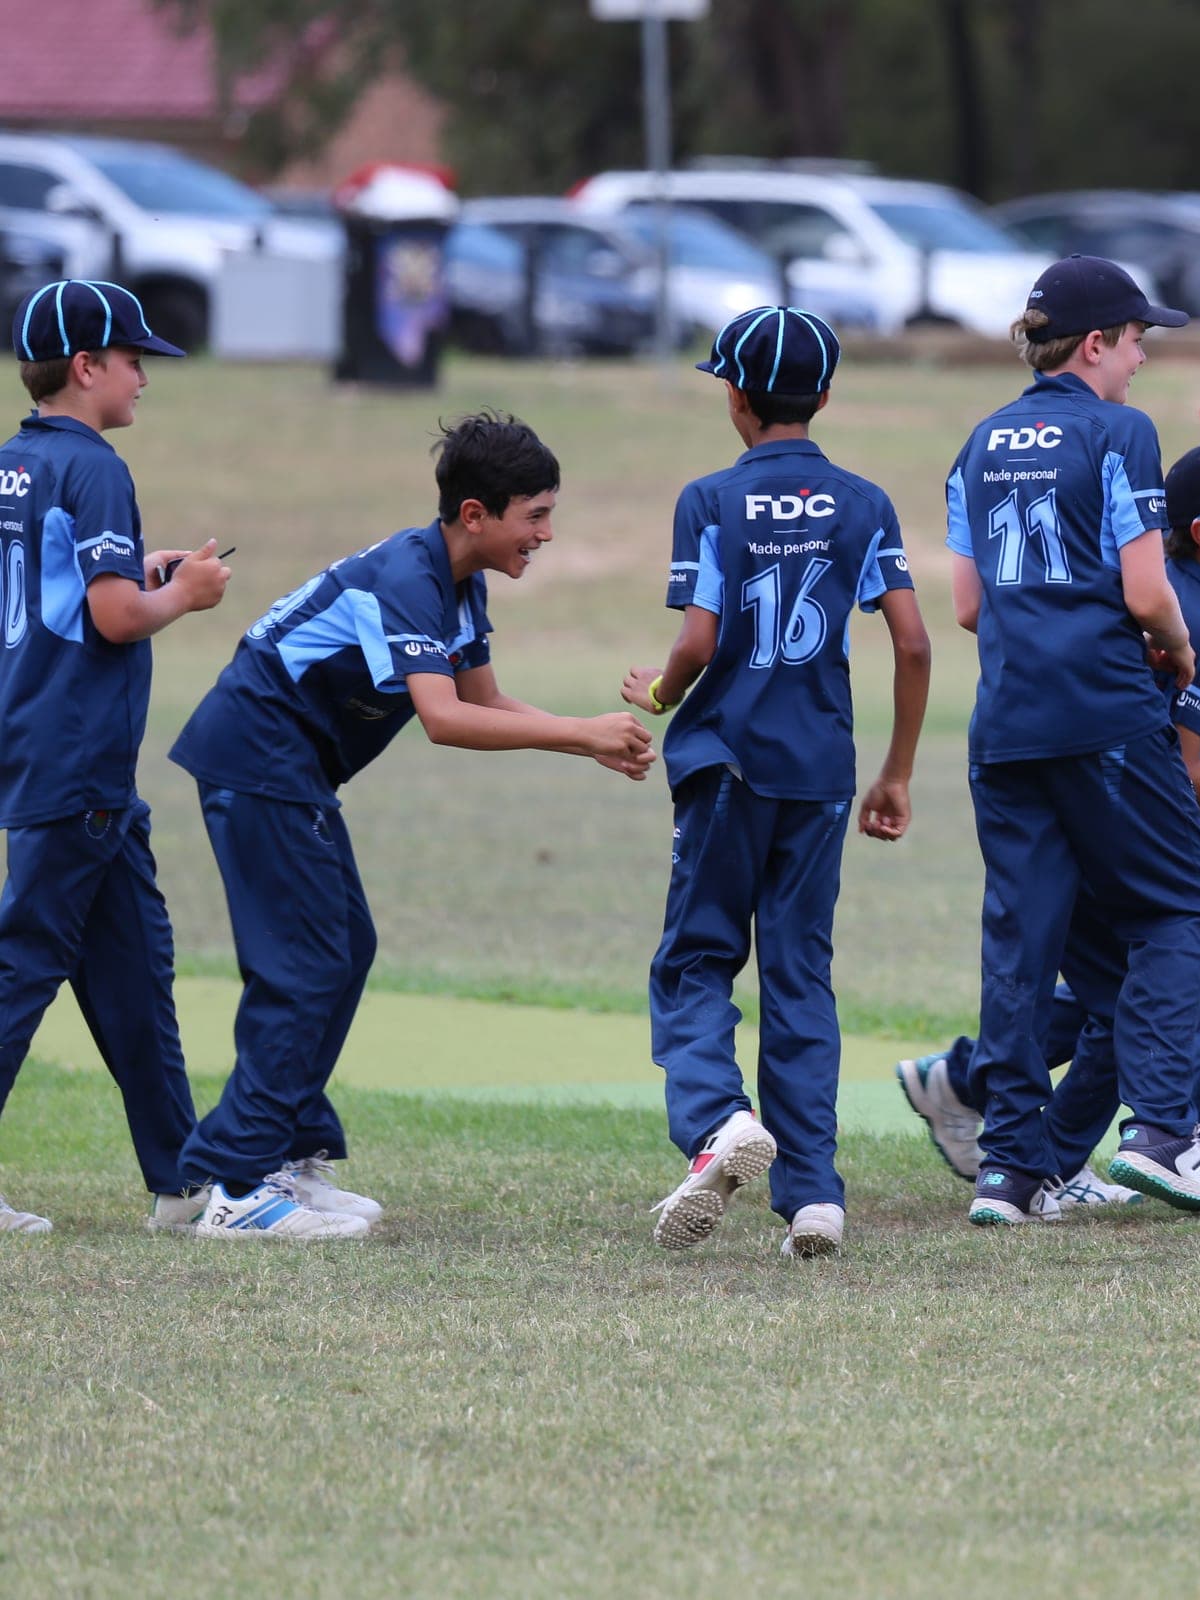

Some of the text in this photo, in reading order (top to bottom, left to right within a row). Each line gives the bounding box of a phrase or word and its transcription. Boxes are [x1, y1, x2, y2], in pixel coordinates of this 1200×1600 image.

[987, 426, 1063, 451] FDC
[0, 469, 31, 497] DC
[983, 467, 1057, 483] Made personal
[745, 493, 836, 521] FDC
[748, 541, 781, 555] Made
[988, 487, 1073, 587] 11
[0, 538, 28, 649] 0
[741, 557, 833, 669] 16
